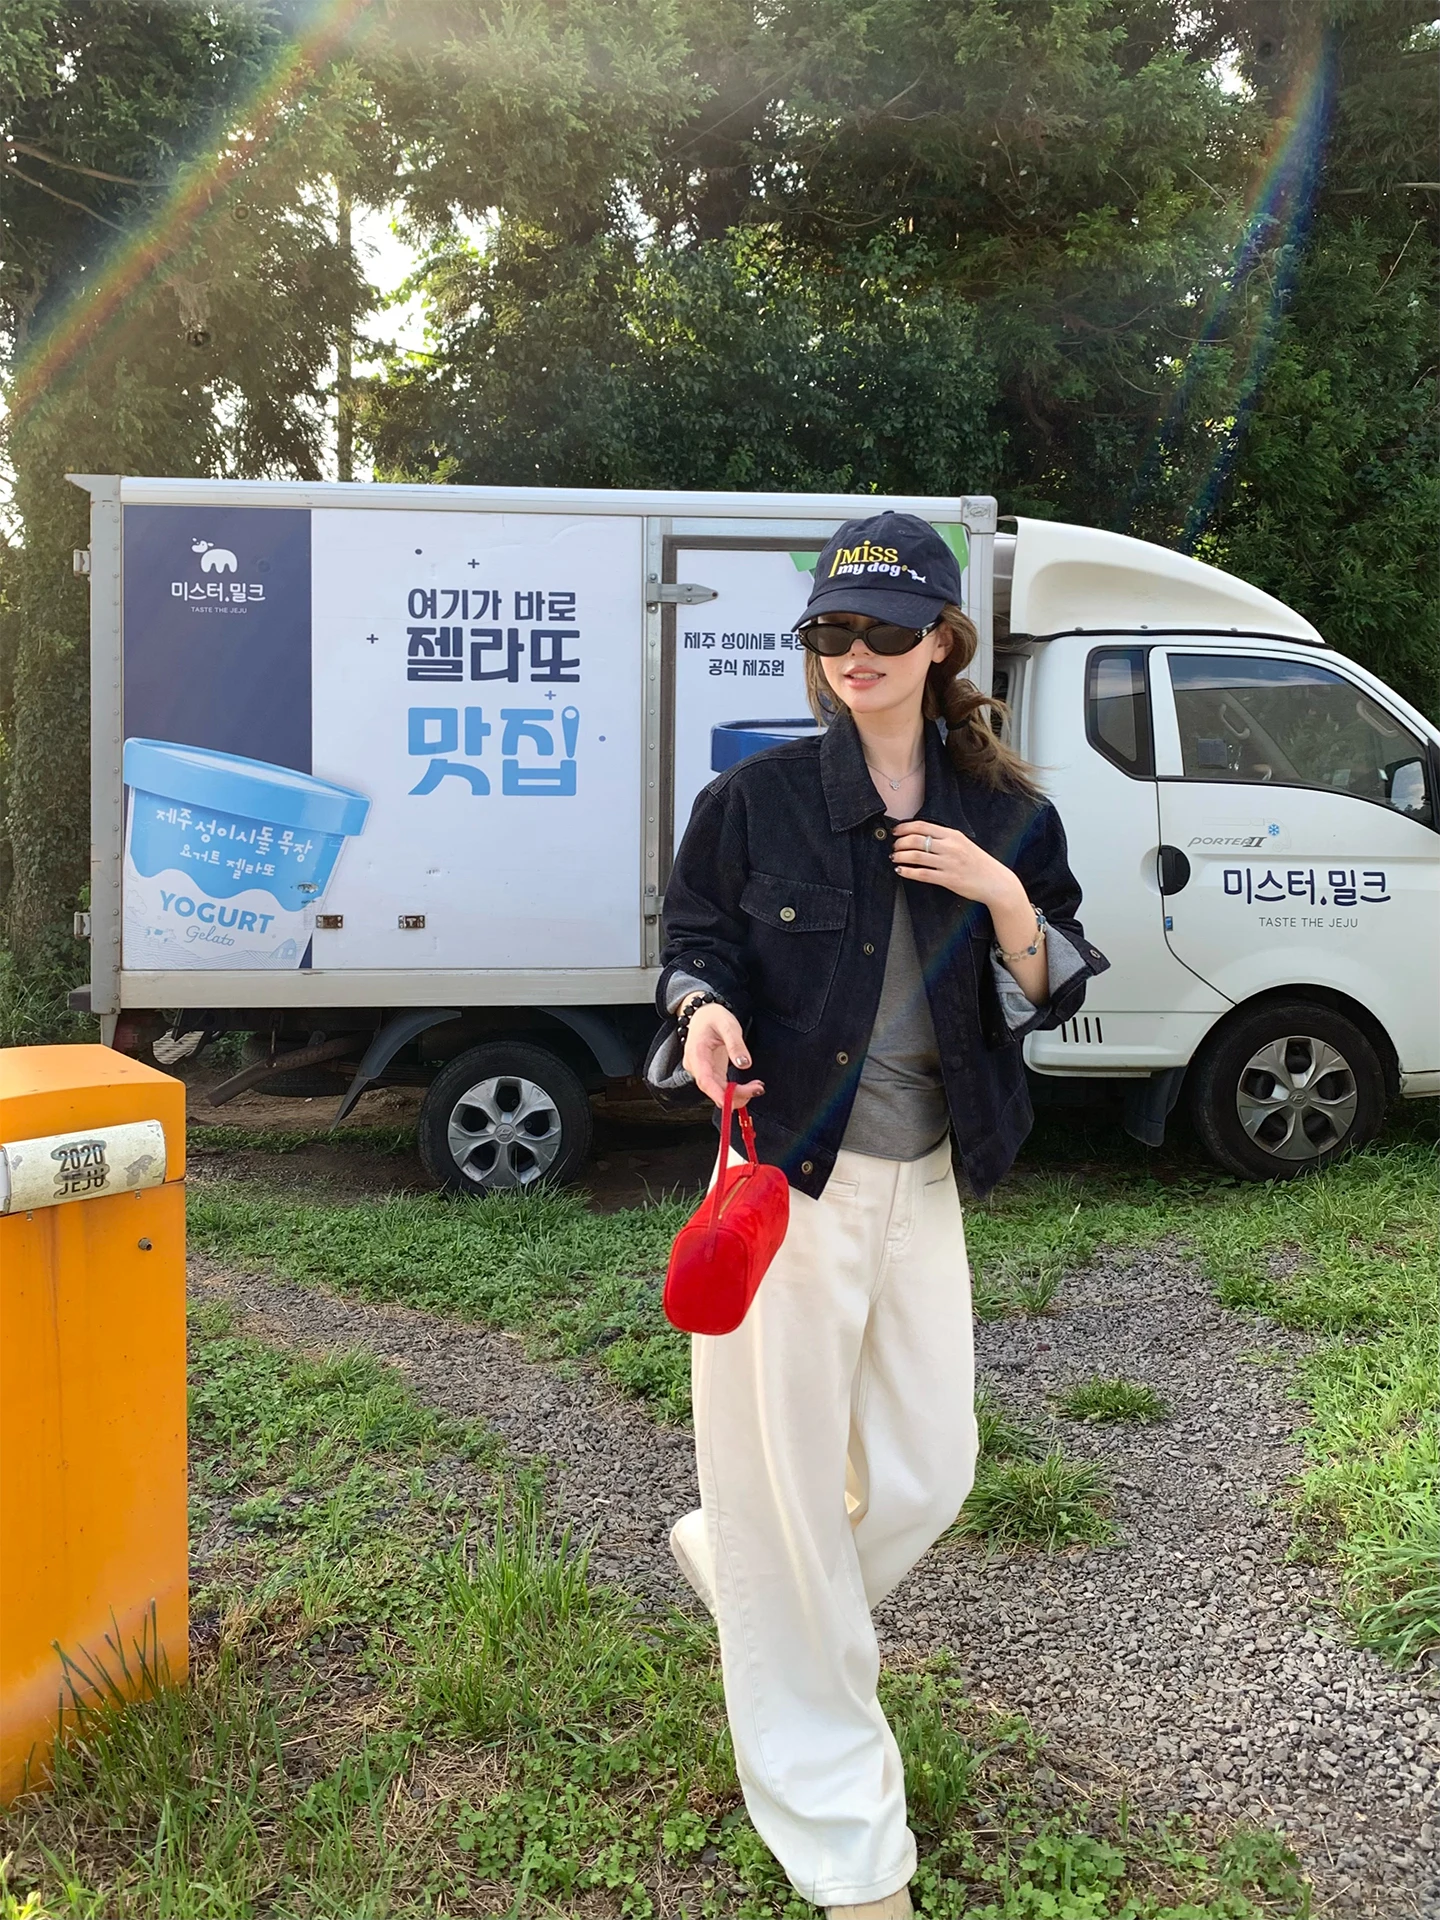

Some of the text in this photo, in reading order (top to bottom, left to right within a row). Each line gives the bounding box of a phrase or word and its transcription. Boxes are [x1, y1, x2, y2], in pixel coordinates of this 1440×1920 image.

[837, 562, 901, 577] my dog
[214, 606, 229, 614] THE
[407, 588, 576, 622] 여기가 바로
[406, 626, 581, 683] 젤라또
[684, 632, 716, 649] 제주
[721, 632, 776, 650] 성이시돌
[708, 659, 785, 677] 공식 제조원
[407, 705, 580, 797] 맛집
[156, 807, 313, 863] 제주 성이시돌 목장
[179, 844, 276, 880] 요거트 젤라또
[159, 890, 275, 935] YOGURT
[1258, 916, 1359, 929] TASTE THE JEJU
[183, 926, 236, 947] Gelato
[58, 1143, 104, 1173] 2020
